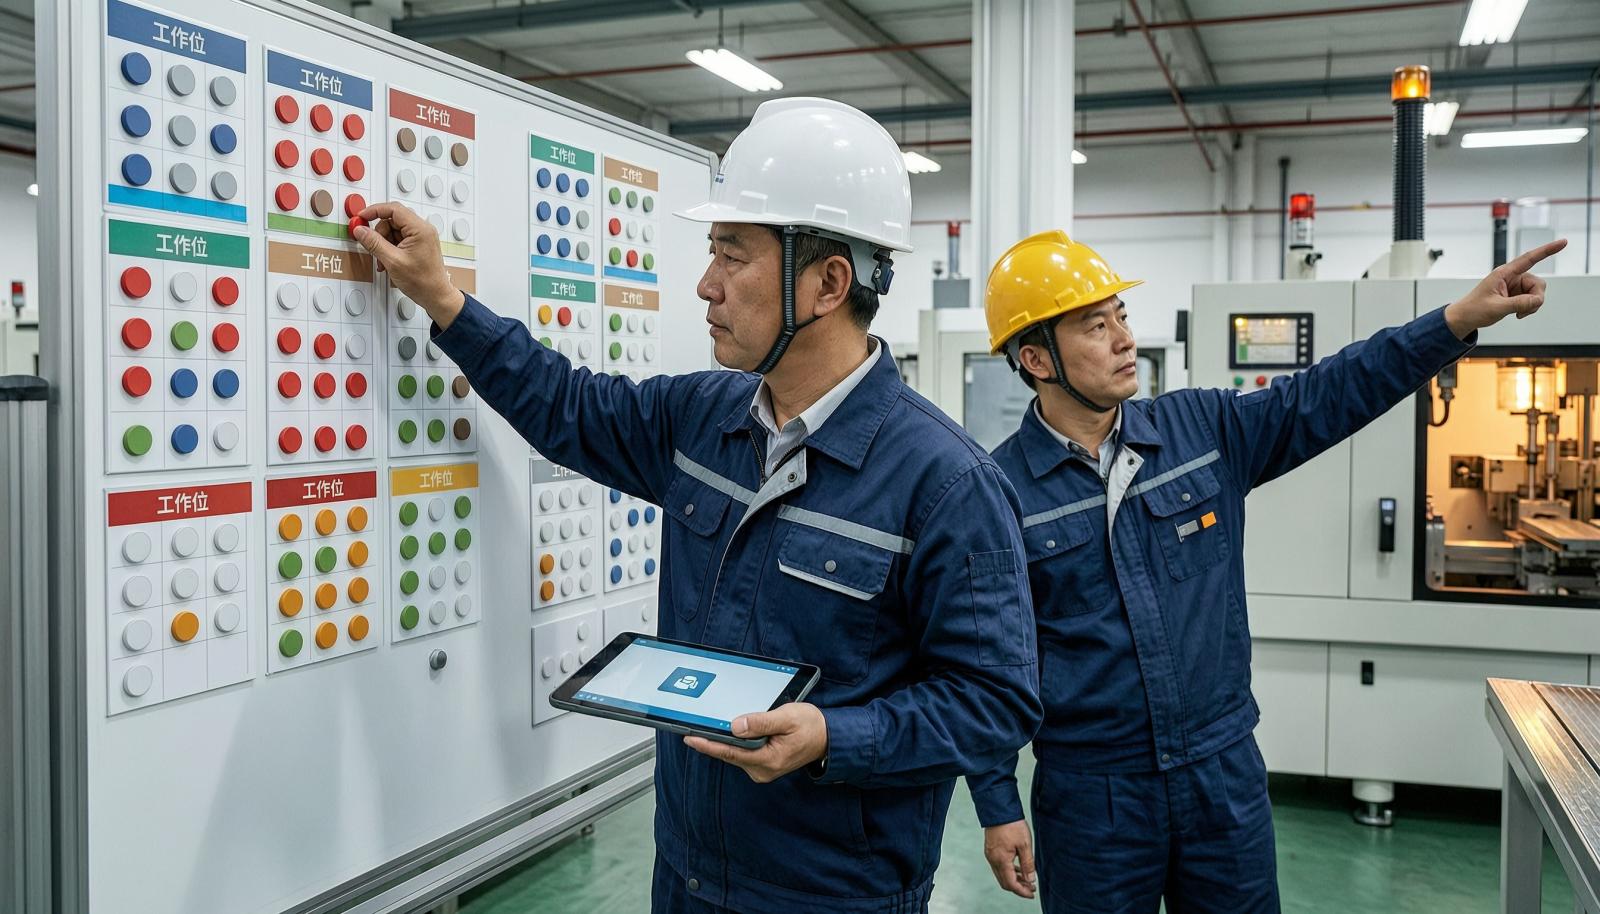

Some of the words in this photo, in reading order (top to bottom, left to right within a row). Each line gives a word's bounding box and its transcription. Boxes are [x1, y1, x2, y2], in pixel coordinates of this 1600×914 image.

[153, 21, 206, 54] 工作位
[300, 68, 343, 96] 工作位
[416, 104, 451, 126] 工作位
[550, 147, 576, 164] 工作位
[155, 233, 208, 258] 工作位
[301, 253, 342, 273] 工作位
[551, 283, 576, 297] 工作位
[419, 471, 453, 487] 工作位
[552, 464, 577, 477] 工作
[302, 480, 344, 499] 工作位
[157, 492, 209, 514] 工作位
